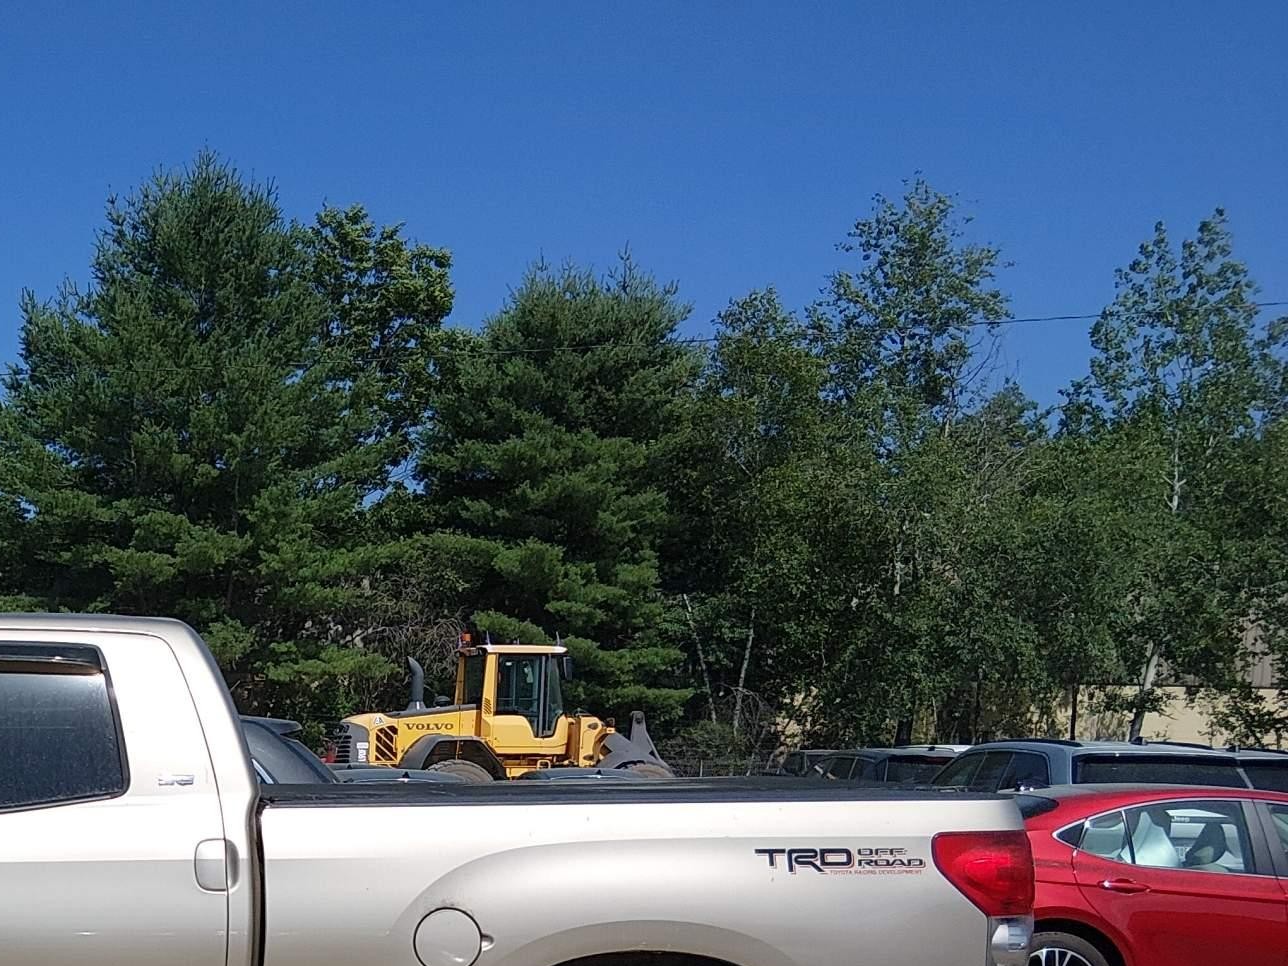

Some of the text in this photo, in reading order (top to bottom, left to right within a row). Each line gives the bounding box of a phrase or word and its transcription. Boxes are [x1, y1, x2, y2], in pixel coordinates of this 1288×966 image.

[405, 723, 454, 731] VOLVO
[755, 848, 855, 874] TRD
[857, 858, 925, 868] ROAD
